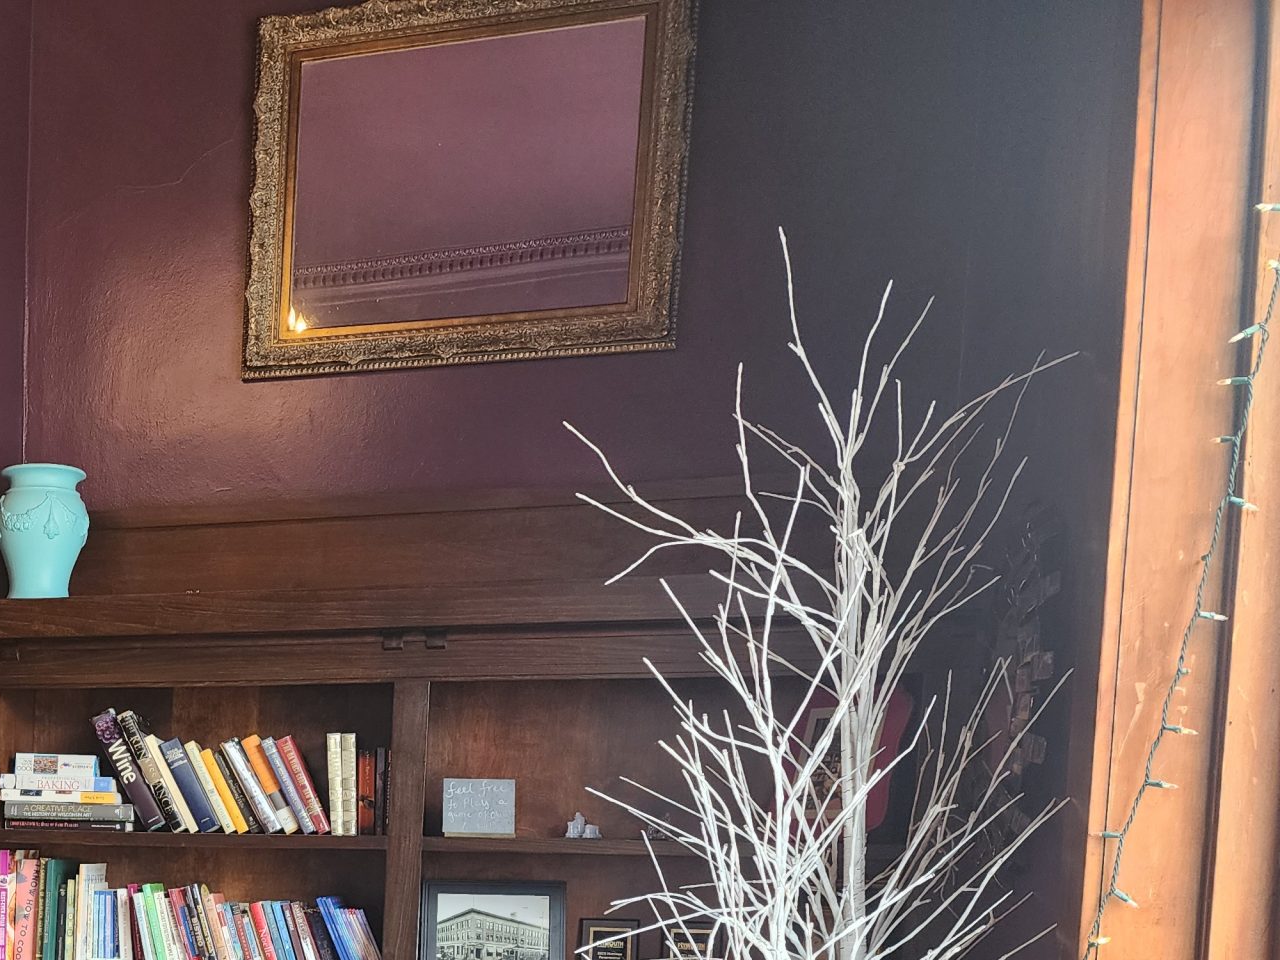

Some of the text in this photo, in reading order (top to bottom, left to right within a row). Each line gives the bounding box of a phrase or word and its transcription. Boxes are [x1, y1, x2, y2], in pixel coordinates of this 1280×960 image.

[108, 738, 136, 784] Wine
[37, 780, 80, 790] BAKING
[446, 781, 506, 798] feel free
[23, 804, 93, 813] A CREATIVE PLACE
[28, 868, 40, 896] KNOW
[22, 898, 33, 920] HOW
[19, 923, 27, 936] TO
[191, 916, 204, 947] BISTRO
